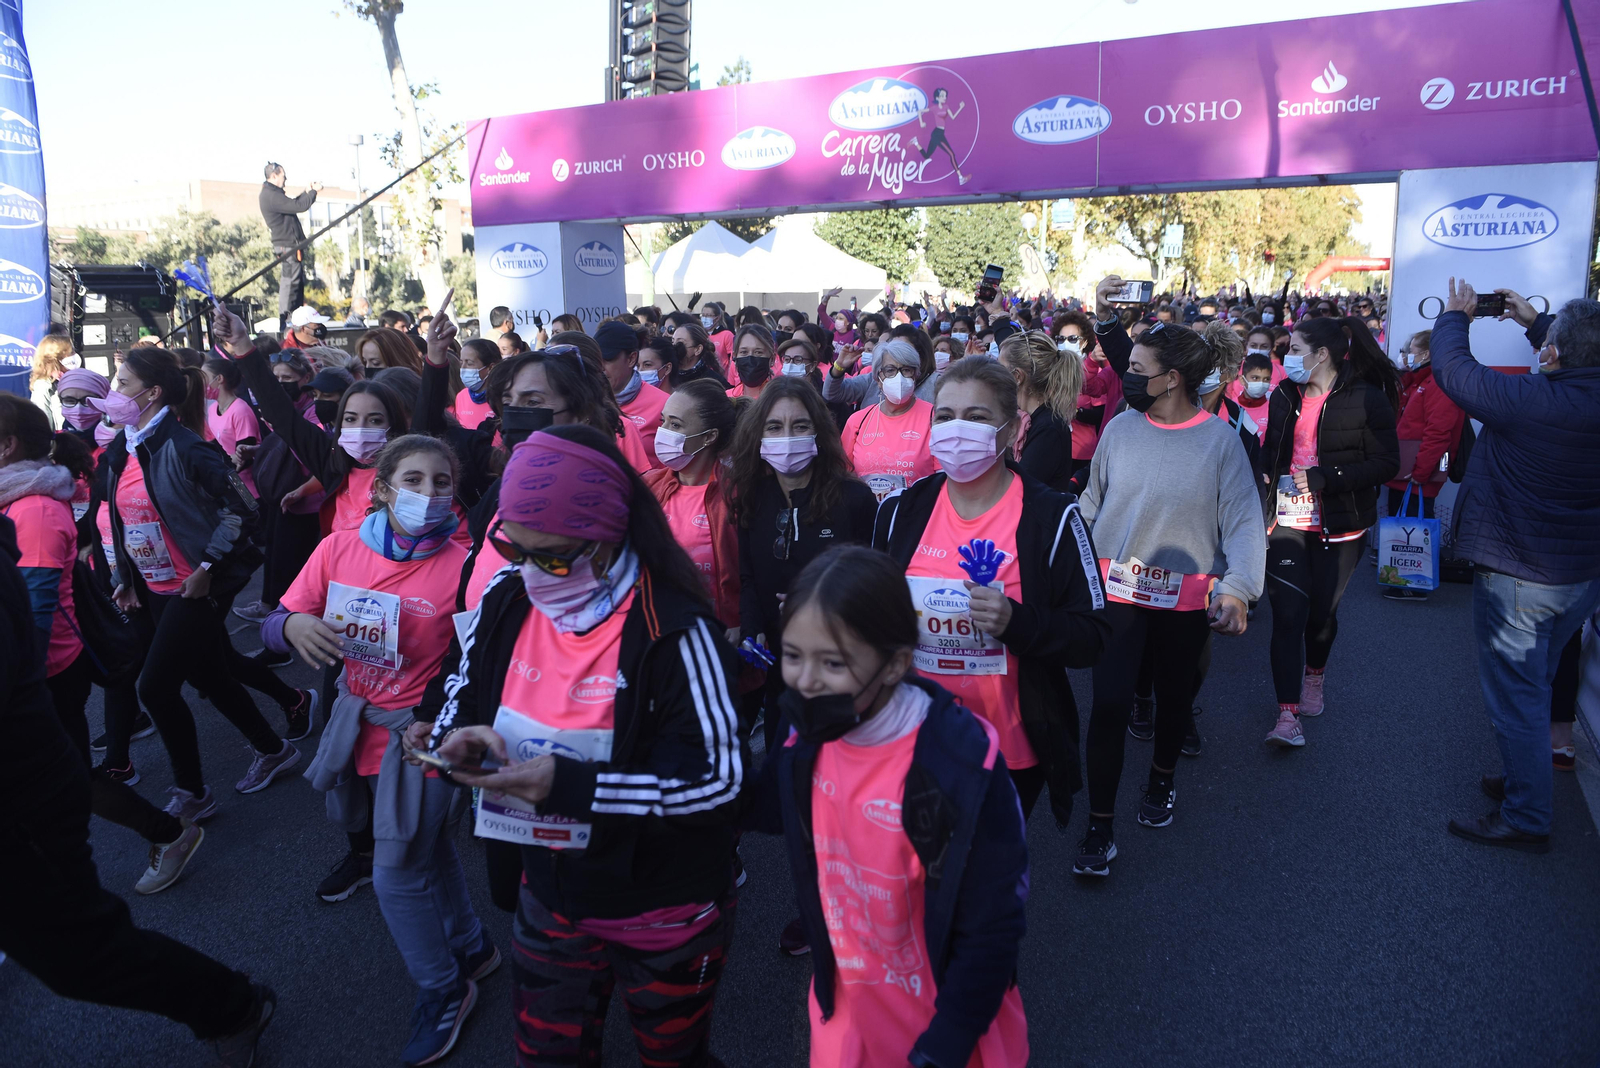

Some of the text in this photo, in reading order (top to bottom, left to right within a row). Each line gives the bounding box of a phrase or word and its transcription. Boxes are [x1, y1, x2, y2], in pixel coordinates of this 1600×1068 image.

[1465, 75, 1567, 101] ZURICH
[838, 99, 919, 120] ASTURIANA
[1144, 99, 1242, 126] OYSHO
[1277, 94, 1381, 118] Santander
[1020, 115, 1103, 135] ASTURIANA
[821, 130, 901, 158] Carrera
[643, 149, 705, 171] OYSHO
[730, 145, 789, 162] ASTURIANA
[574, 158, 623, 176] ZURICH
[841, 150, 932, 195] de la Mujer
[479, 170, 531, 187] Santander
[1500, 211, 1545, 219] LECHERA
[1431, 216, 1548, 237] ASTURIANA
[495, 256, 544, 269] ASTURIANA
[578, 253, 616, 268] ASTURIANA
[896, 460, 915, 468] POR
[886, 469, 914, 477] TODAS
[131, 497, 148, 507] POR
[1291, 494, 1316, 504] 016
[132, 547, 151, 558] 016
[1080, 539, 1093, 566] FASTER
[1393, 545, 1422, 553] YBARRA
[1131, 563, 1162, 580] 016
[1090, 575, 1102, 605] MOVING
[1108, 584, 1130, 596] OYSHO
[348, 603, 383, 617] ASTURIANA
[401, 602, 433, 616] ASTURIANA
[926, 596, 969, 608] ASTURIANA
[345, 622, 380, 643] 016
[927, 617, 971, 636] 016
[351, 642, 369, 654] 2927
[937, 638, 960, 648] 3203
[944, 647, 954, 655] DE
[369, 656, 385, 665] MUJER
[361, 663, 406, 680] TODAS
[504, 808, 541, 823] CARRERA
[543, 814, 556, 823] DE
[556, 815, 569, 824] LA
[483, 818, 527, 837] OYSHO
